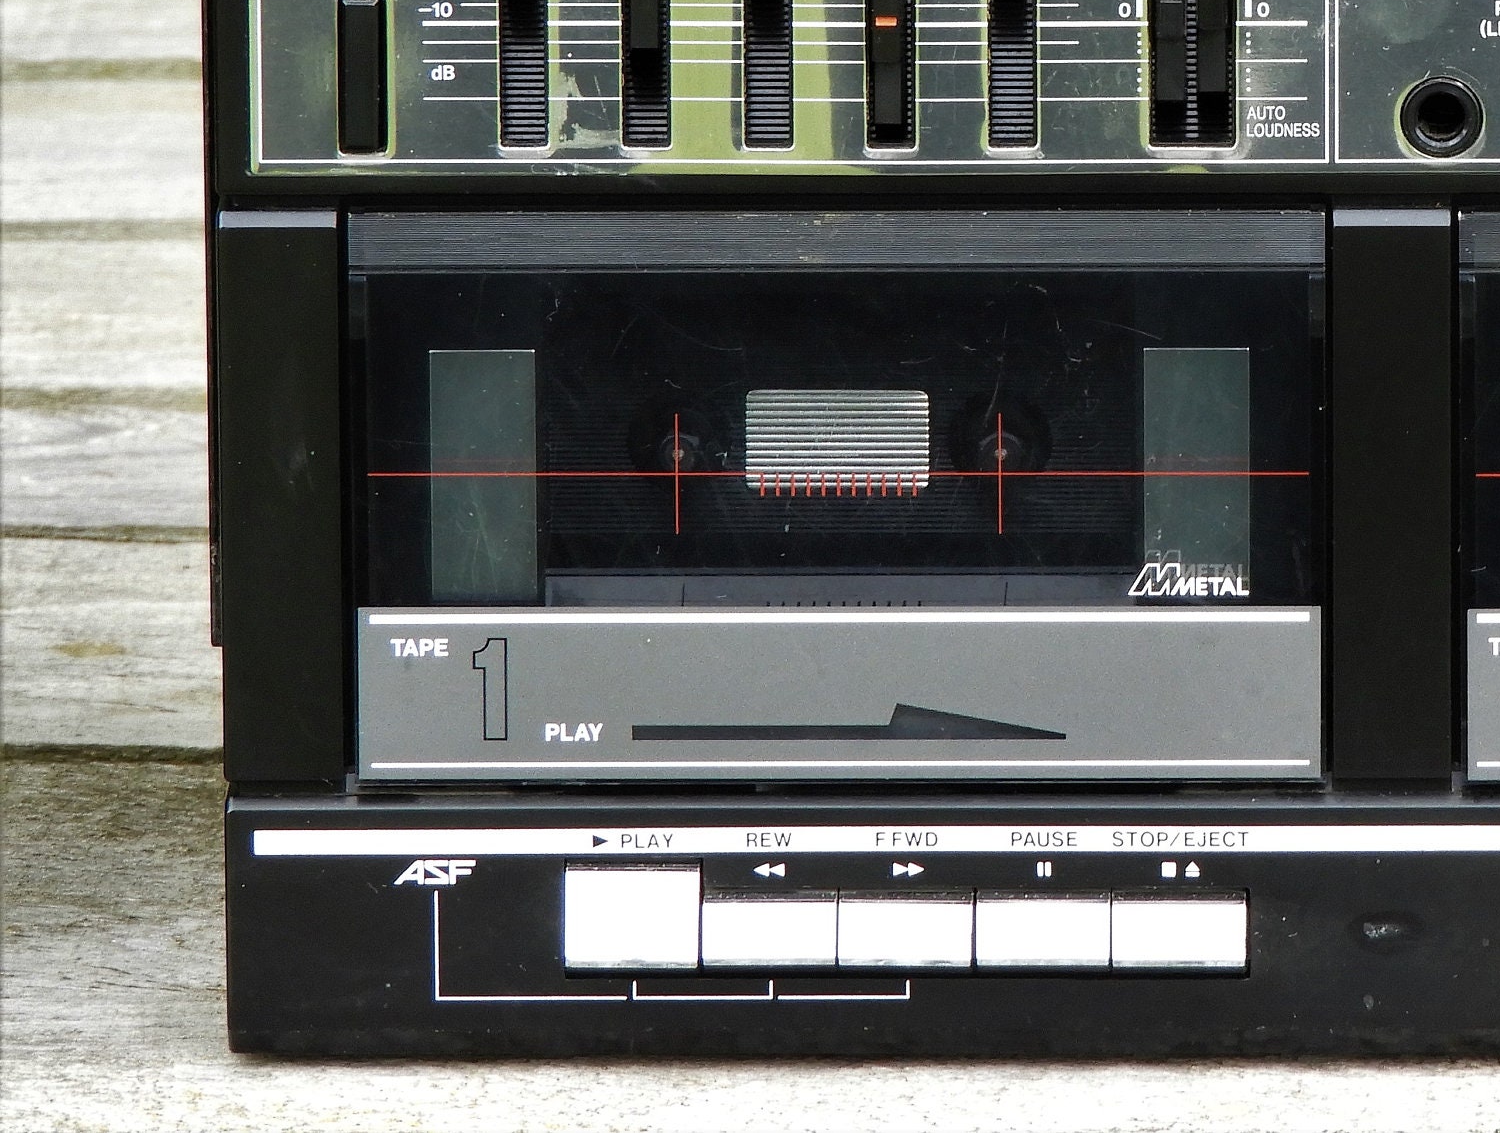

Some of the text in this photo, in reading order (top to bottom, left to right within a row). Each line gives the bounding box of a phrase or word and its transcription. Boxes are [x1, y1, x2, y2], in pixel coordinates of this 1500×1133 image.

[1119, 3, 1131, 18] 0
[1257, 2, 1269, 17] 0
[431, 65, 455, 80] dB
[1247, 106, 1285, 120] AUTO
[1246, 123, 1320, 138] LOUDNESS
[390, 638, 508, 741] TAPE 1
[545, 723, 603, 741] PLAY
[622, 834, 672, 848] PLAY
[747, 833, 791, 847] REW
[1012, 832, 1076, 846] PAUSE
[1113, 832, 1248, 847] STOP/EJECT
